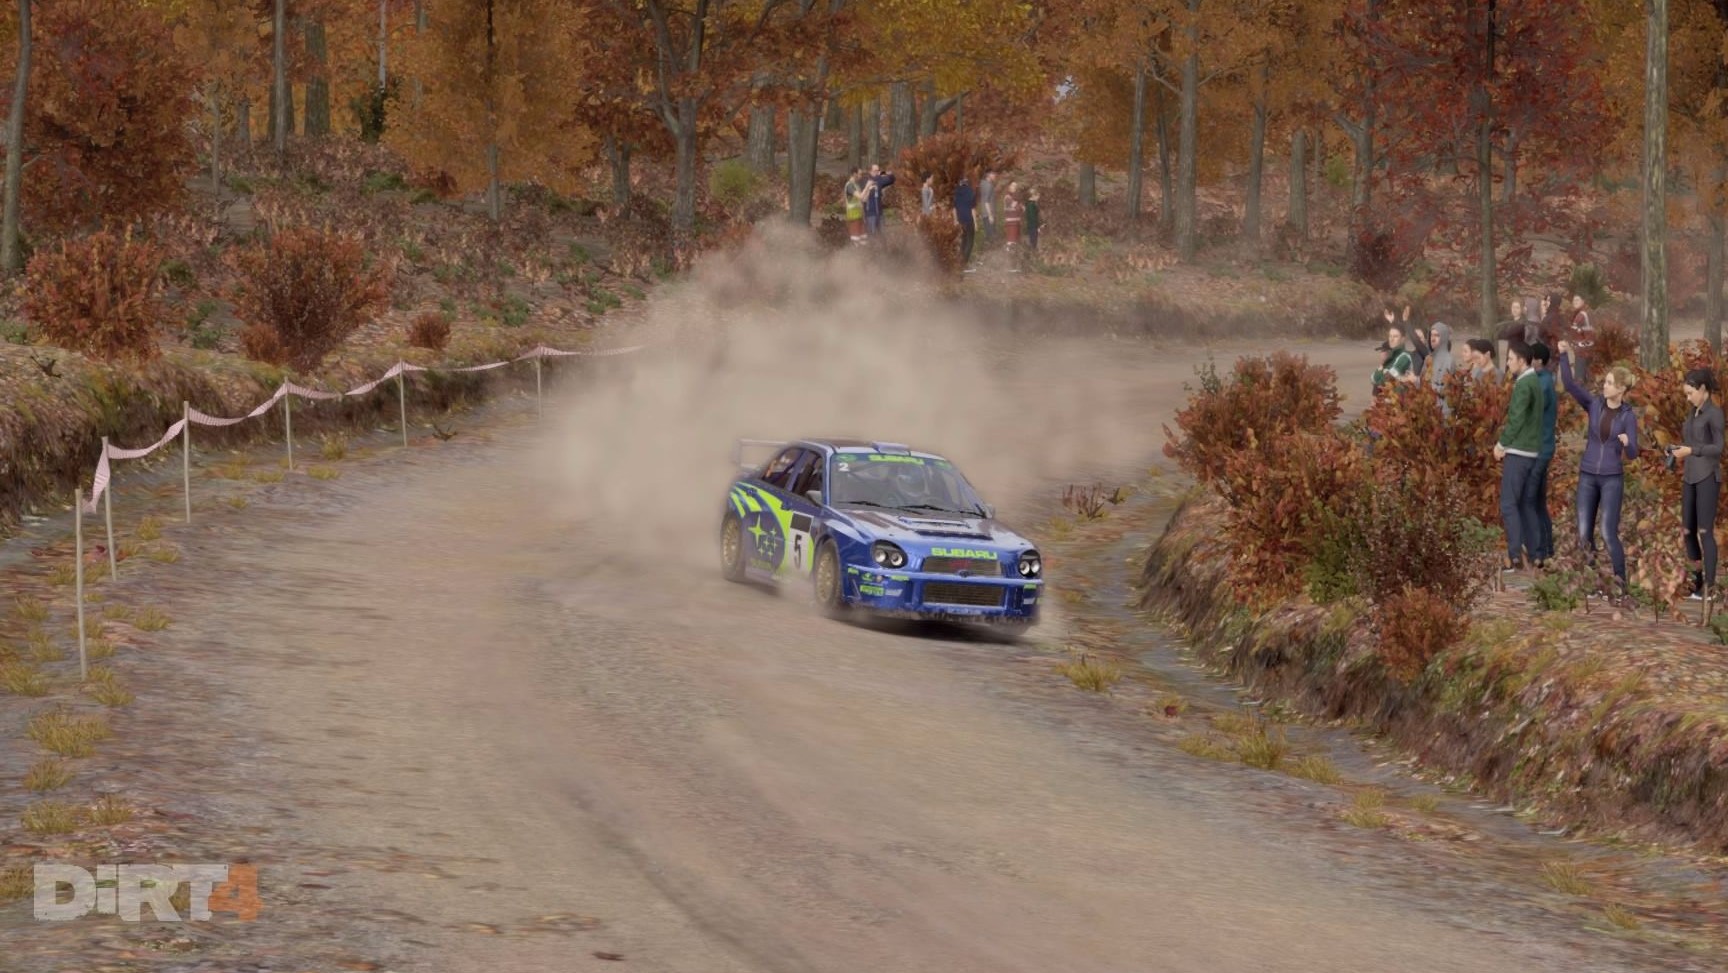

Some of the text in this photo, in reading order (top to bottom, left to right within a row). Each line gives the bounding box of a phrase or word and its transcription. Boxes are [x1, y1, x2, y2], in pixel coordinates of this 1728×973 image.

[868, 454, 924, 465] SUBARU
[838, 462, 850, 472] 2
[793, 534, 803, 568] 5
[931, 547, 998, 560] SUBARU
